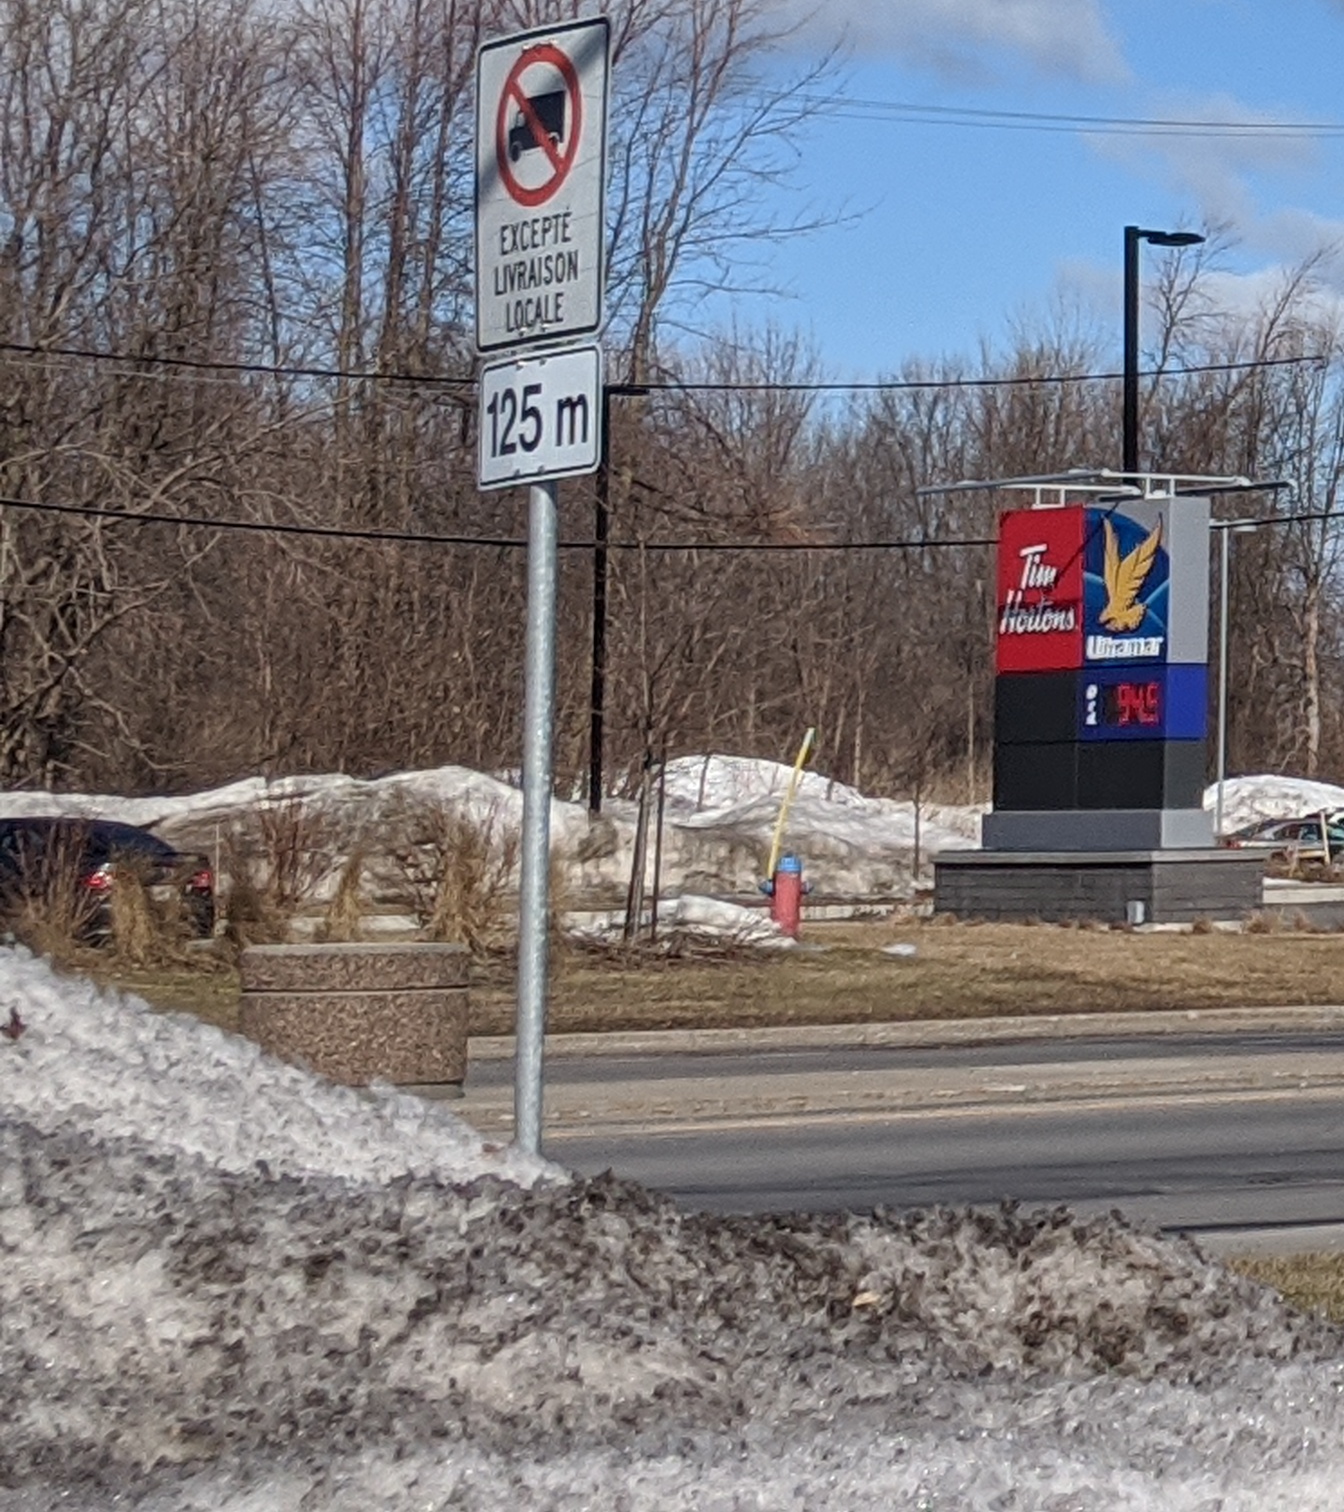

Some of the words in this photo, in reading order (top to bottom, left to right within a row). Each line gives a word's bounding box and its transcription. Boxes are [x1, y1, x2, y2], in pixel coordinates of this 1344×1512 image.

[500, 205, 573, 256] EXCEPTÉ
[494, 249, 579, 296] LIVRAISON
[506, 292, 565, 333] LOCALE
[487, 382, 543, 459] 125
[555, 393, 589, 448] m
[1019, 543, 1058, 591] Tim
[1000, 589, 1075, 635] Hortons
[1086, 635, 1164, 660] Ultramar
